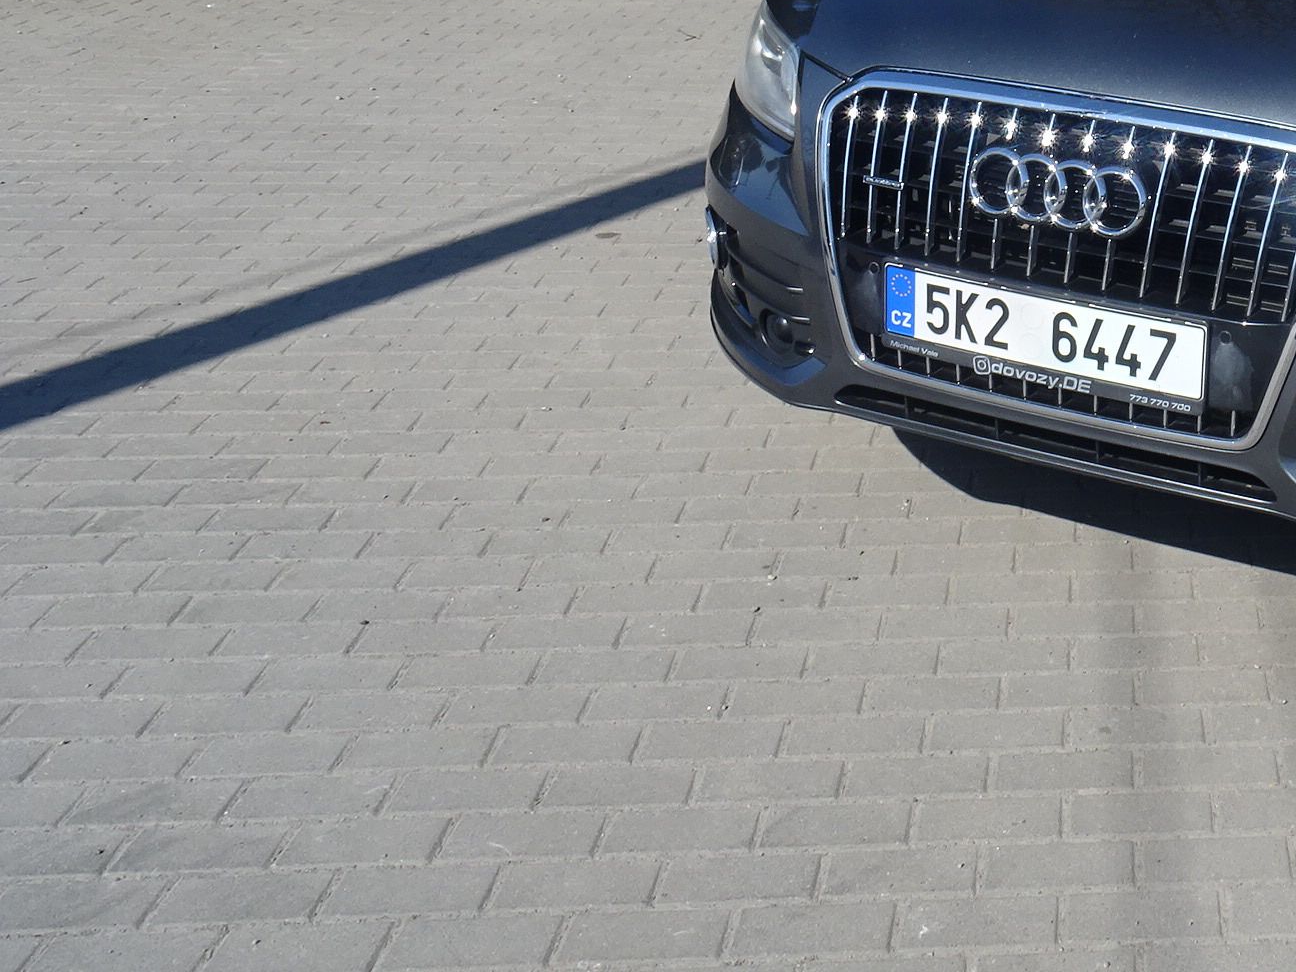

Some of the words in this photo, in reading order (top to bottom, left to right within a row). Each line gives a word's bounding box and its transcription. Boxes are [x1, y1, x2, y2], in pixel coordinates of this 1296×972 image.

[891, 309, 912, 328] CZ
[926, 283, 1010, 351] 5K2
[1052, 311, 1177, 382] 6447
[991, 362, 1092, 394] dovozy.DE
[1129, 393, 1149, 404] 773
